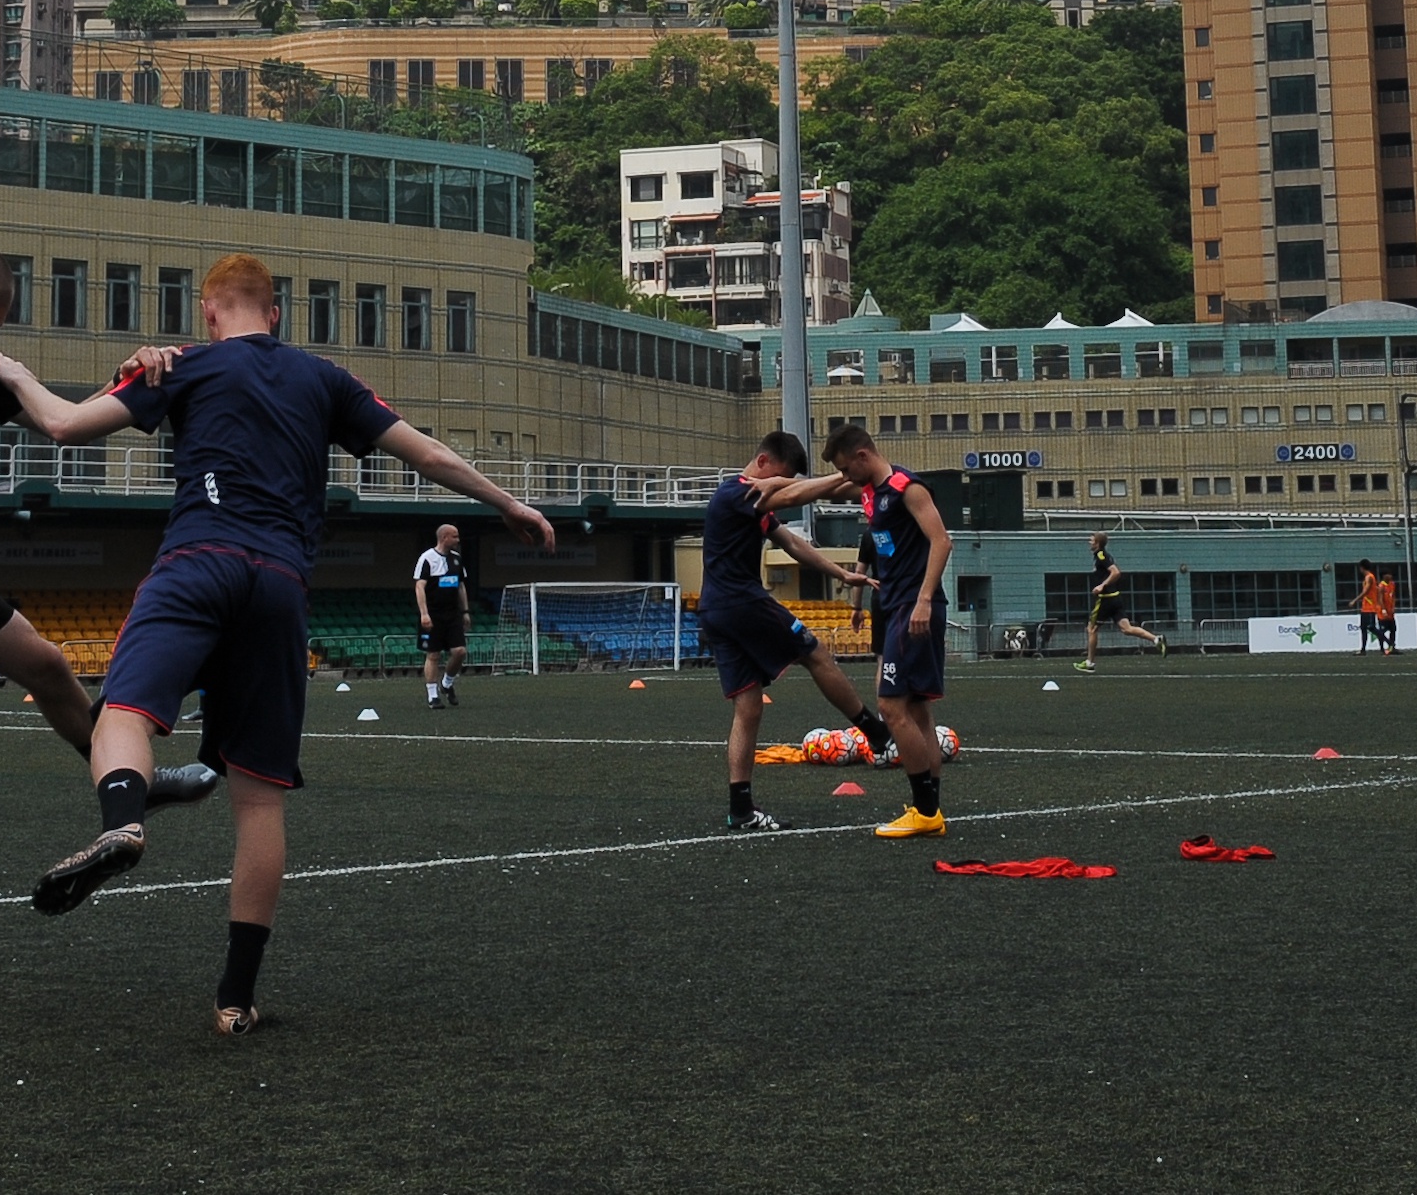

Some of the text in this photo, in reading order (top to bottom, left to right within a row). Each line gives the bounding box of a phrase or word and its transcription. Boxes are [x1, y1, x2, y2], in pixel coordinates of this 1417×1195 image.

[1293, 445, 1337, 460] 2400
[982, 453, 1023, 467] 1000
[883, 662, 897, 674] 56
